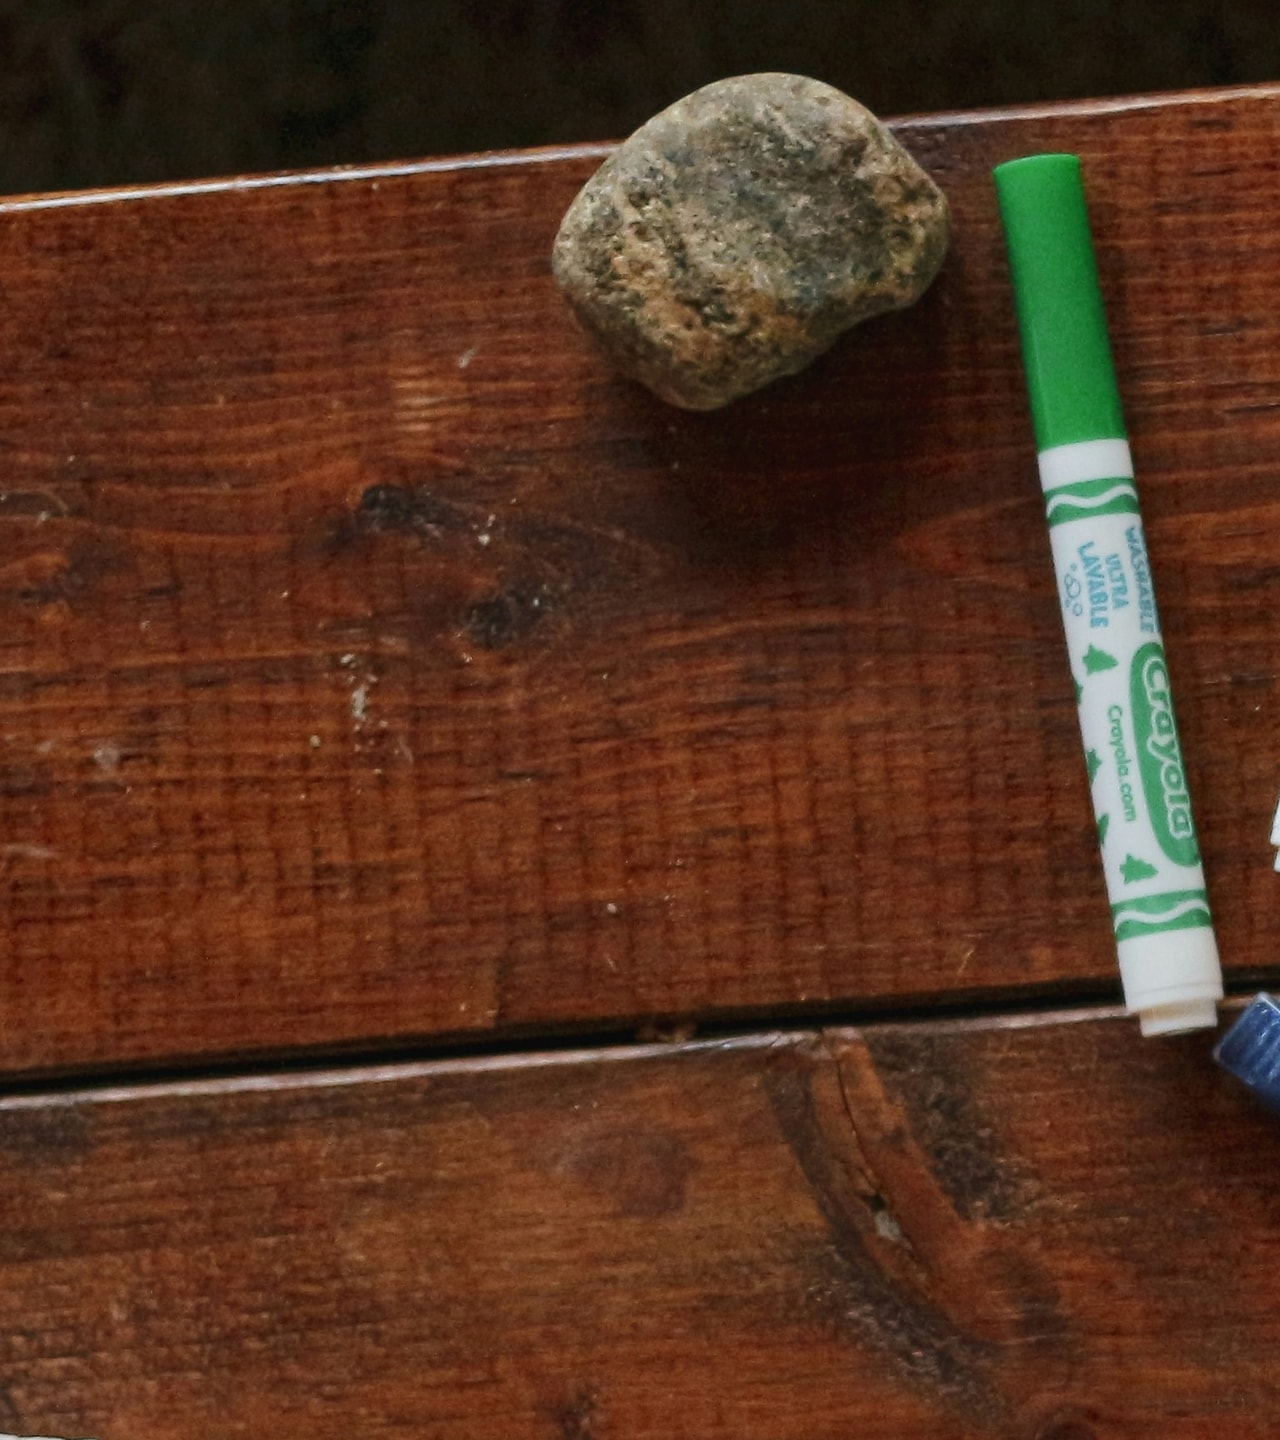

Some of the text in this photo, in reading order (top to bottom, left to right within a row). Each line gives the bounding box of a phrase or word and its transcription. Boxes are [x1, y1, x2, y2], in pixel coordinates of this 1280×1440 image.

[1076, 540, 1112, 629] LAVABLE
[1103, 553, 1130, 609] ULTRA
[1123, 526, 1157, 635] WASHABLE
[1103, 702, 1140, 823] Crayola.com
[1132, 654, 1195, 840] Crayola
